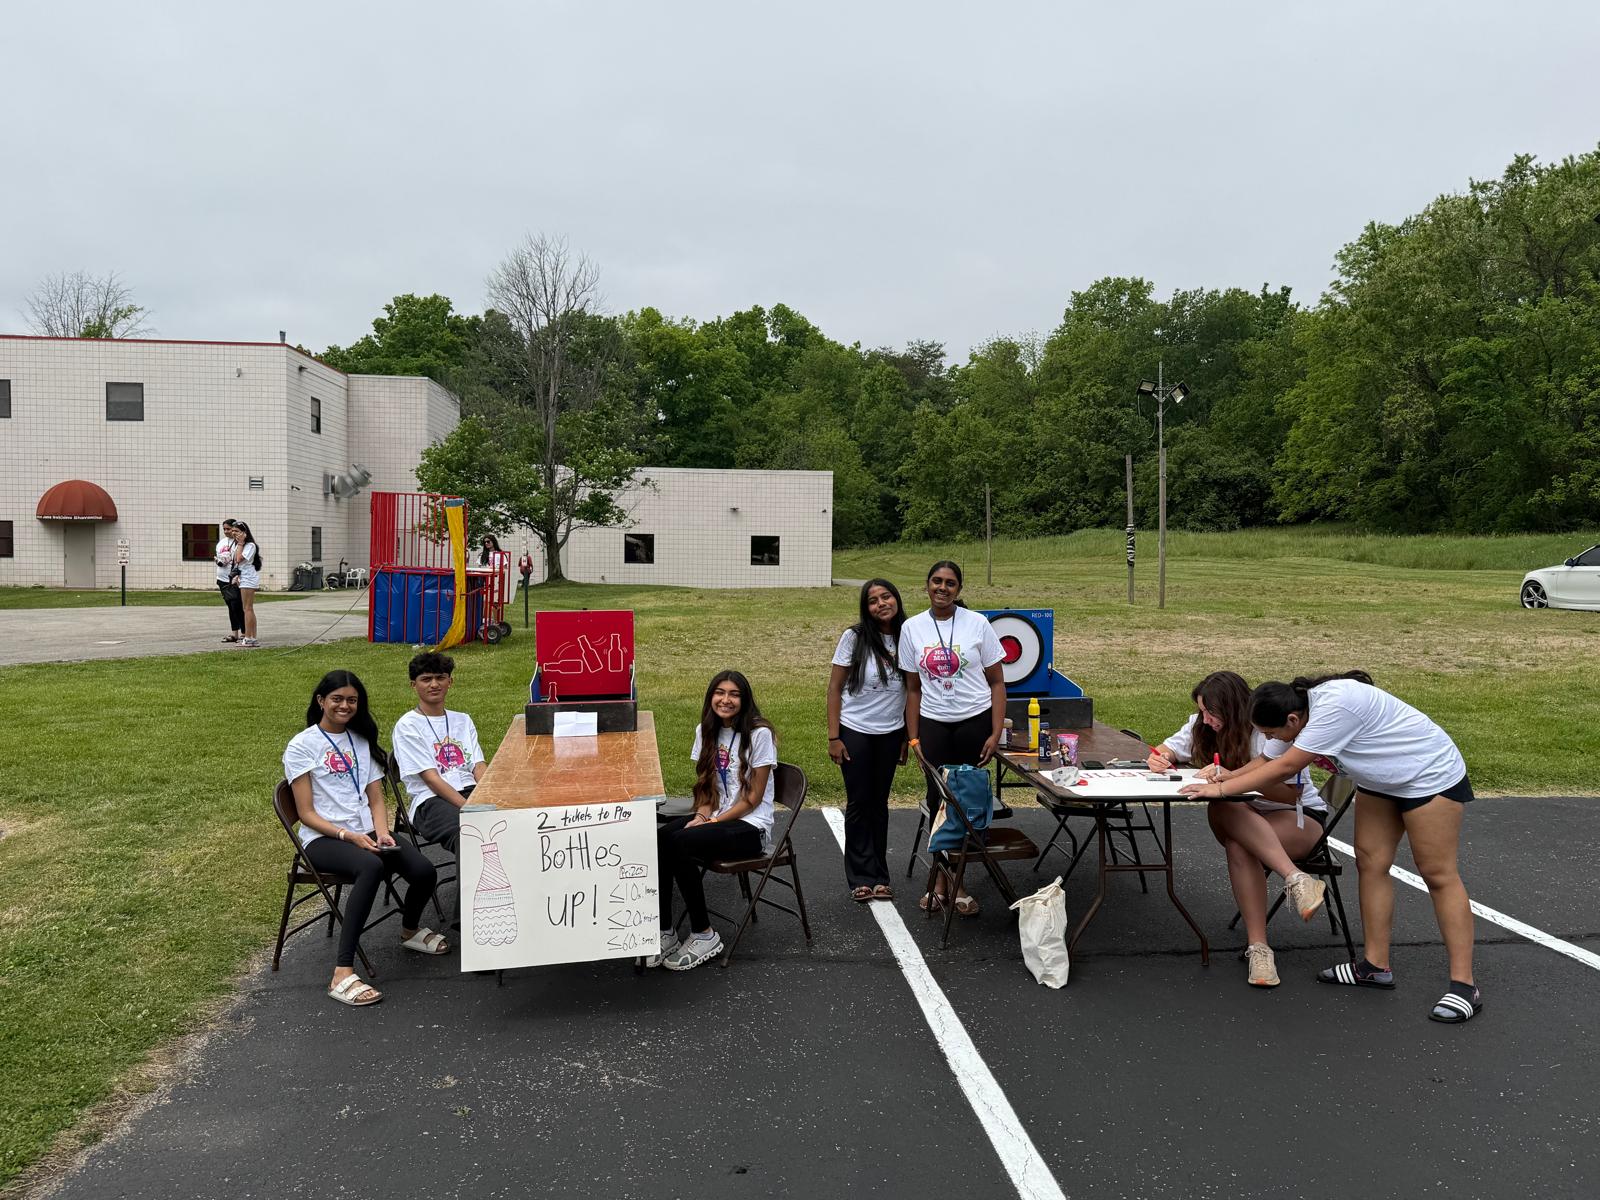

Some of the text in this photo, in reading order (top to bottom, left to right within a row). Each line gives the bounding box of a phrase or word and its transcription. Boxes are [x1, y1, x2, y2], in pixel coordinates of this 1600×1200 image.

[536, 805, 632, 830] 2 tickets to Play
[540, 830, 622, 872] Bottles
